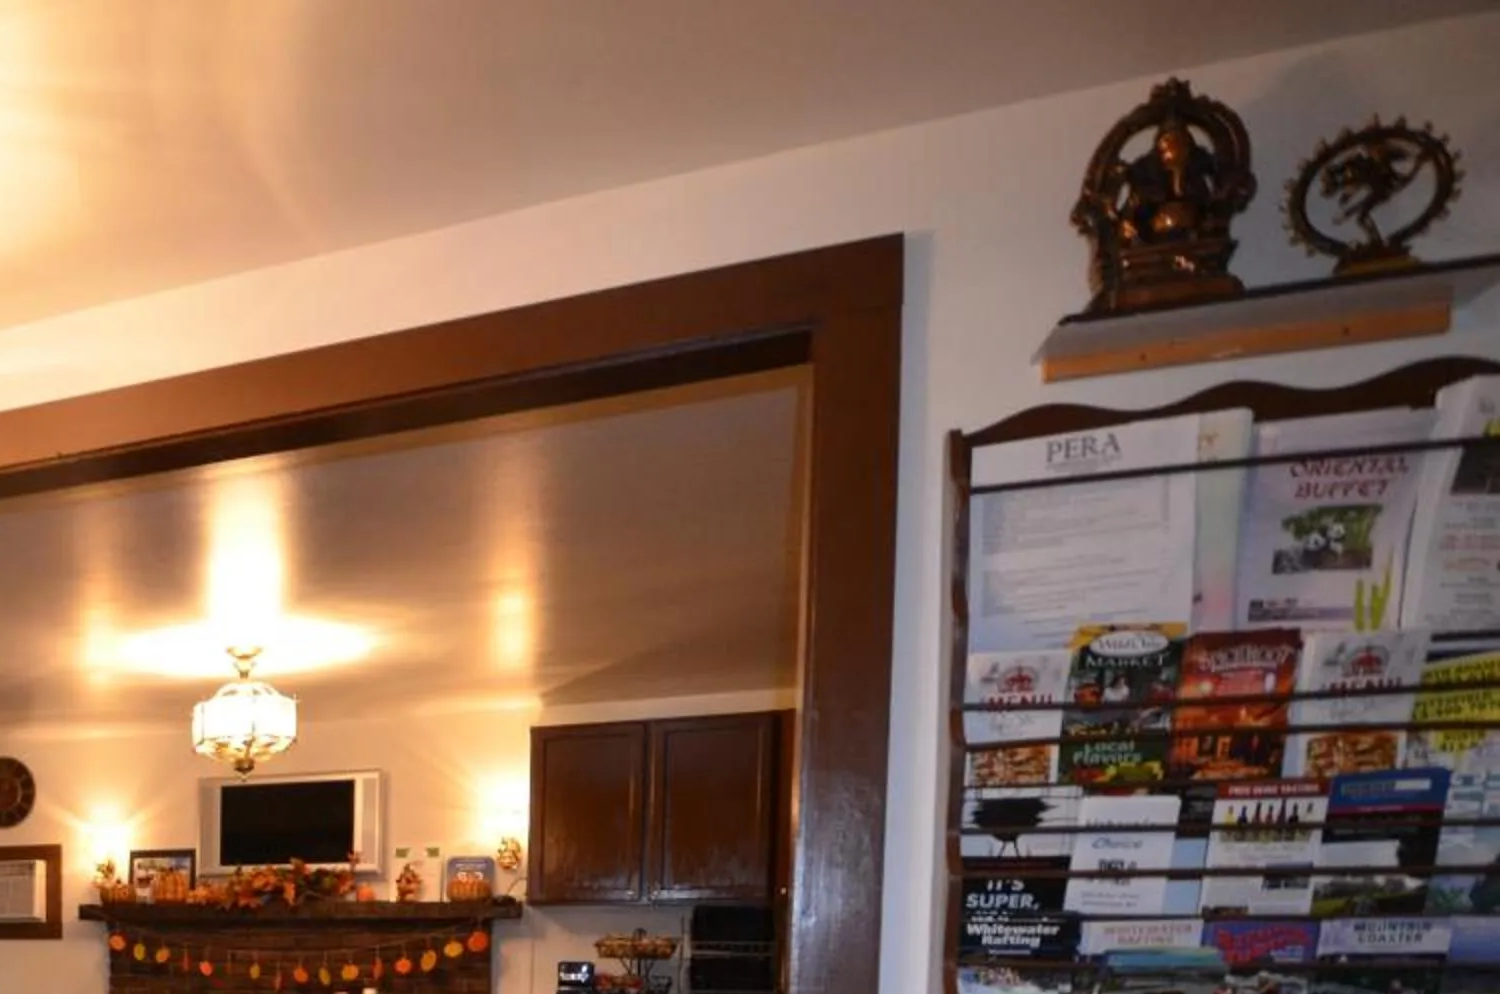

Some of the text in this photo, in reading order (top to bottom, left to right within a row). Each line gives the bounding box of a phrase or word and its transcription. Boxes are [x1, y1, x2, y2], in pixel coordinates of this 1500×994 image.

[1046, 432, 1122, 464] PERA
[1289, 455, 1410, 479] ORIENTAL
[1294, 480, 1390, 501] BUFFET
[965, 893, 1041, 912] SUPER,
[966, 922, 1061, 937] Whitewater
[981, 934, 1041, 949] Rafting
[1358, 934, 1423, 946] COASTER
